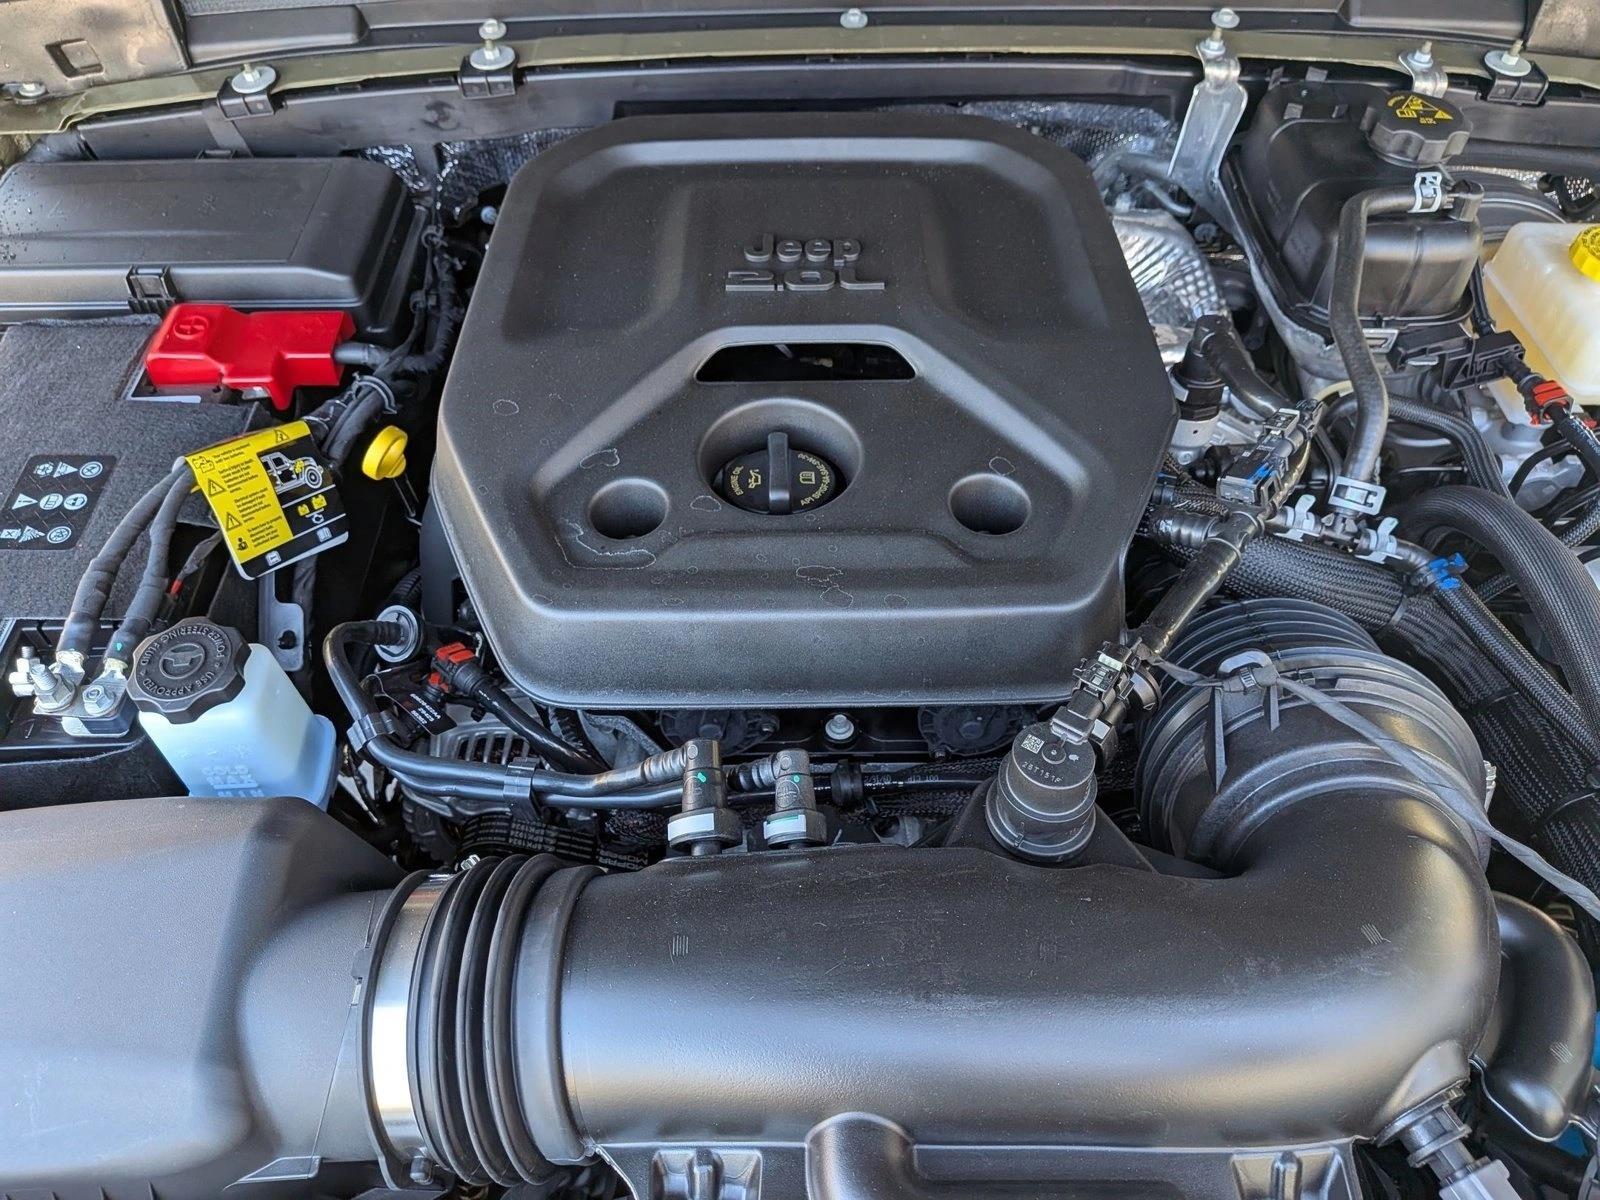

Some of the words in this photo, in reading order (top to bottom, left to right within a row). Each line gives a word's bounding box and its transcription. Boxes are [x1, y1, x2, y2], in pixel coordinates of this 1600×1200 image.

[744, 232, 861, 266] Jeep
[726, 269, 885, 291] 2.0L
[800, 496, 814, 506] API
[160, 626, 209, 643] STEERING
[208, 631, 226, 658] POWER
[140, 642, 160, 666] FLUID
[142, 678, 193, 696] APPROVED
[196, 671, 215, 687] USE
